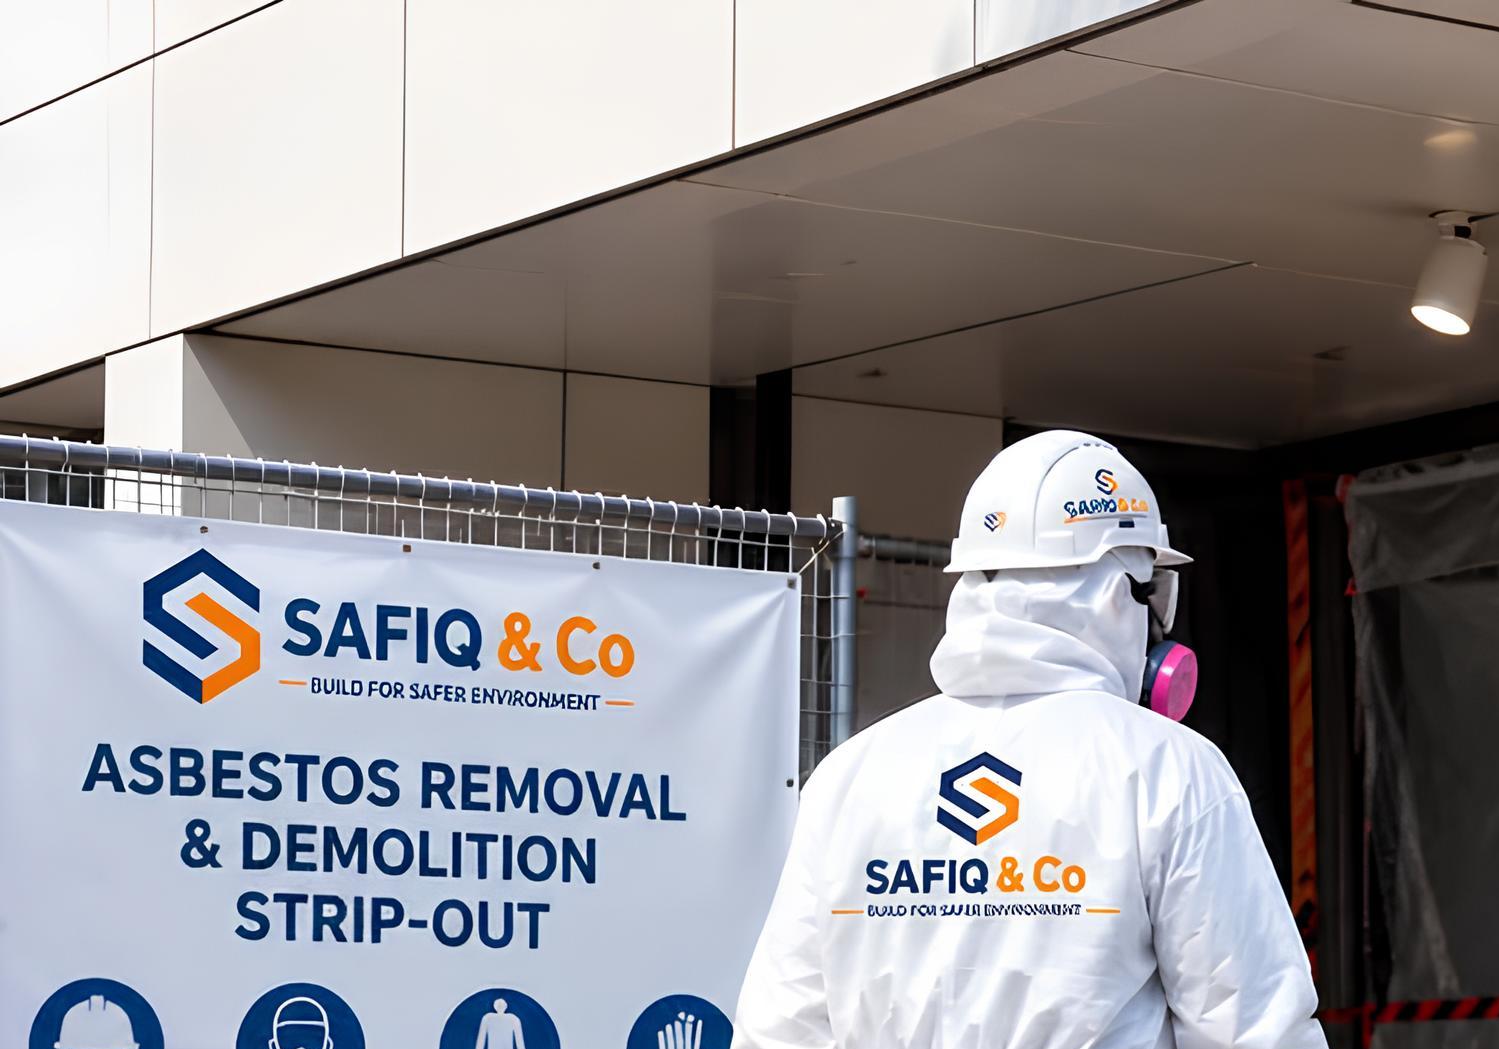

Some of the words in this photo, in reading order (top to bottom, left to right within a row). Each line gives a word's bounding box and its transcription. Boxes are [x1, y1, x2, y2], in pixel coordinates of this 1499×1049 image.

[282, 598, 482, 671] SAFIQ
[498, 612, 542, 672] &
[557, 616, 634, 678] Co
[312, 677, 363, 696] BUILD
[368, 681, 404, 698] FOR
[410, 683, 466, 702] SAFER
[472, 687, 600, 710] ENVIRONMENT
[82, 744, 400, 807] ASBESTOS
[421, 762, 686, 821] REMOVAL
[181, 819, 222, 868] &
[243, 822, 597, 884] DEMOLITION
[866, 859, 988, 894] SAFIQ
[996, 856, 1024, 893] &
[1033, 856, 1086, 893] Co
[235, 891, 550, 949] STRIP-OUT
